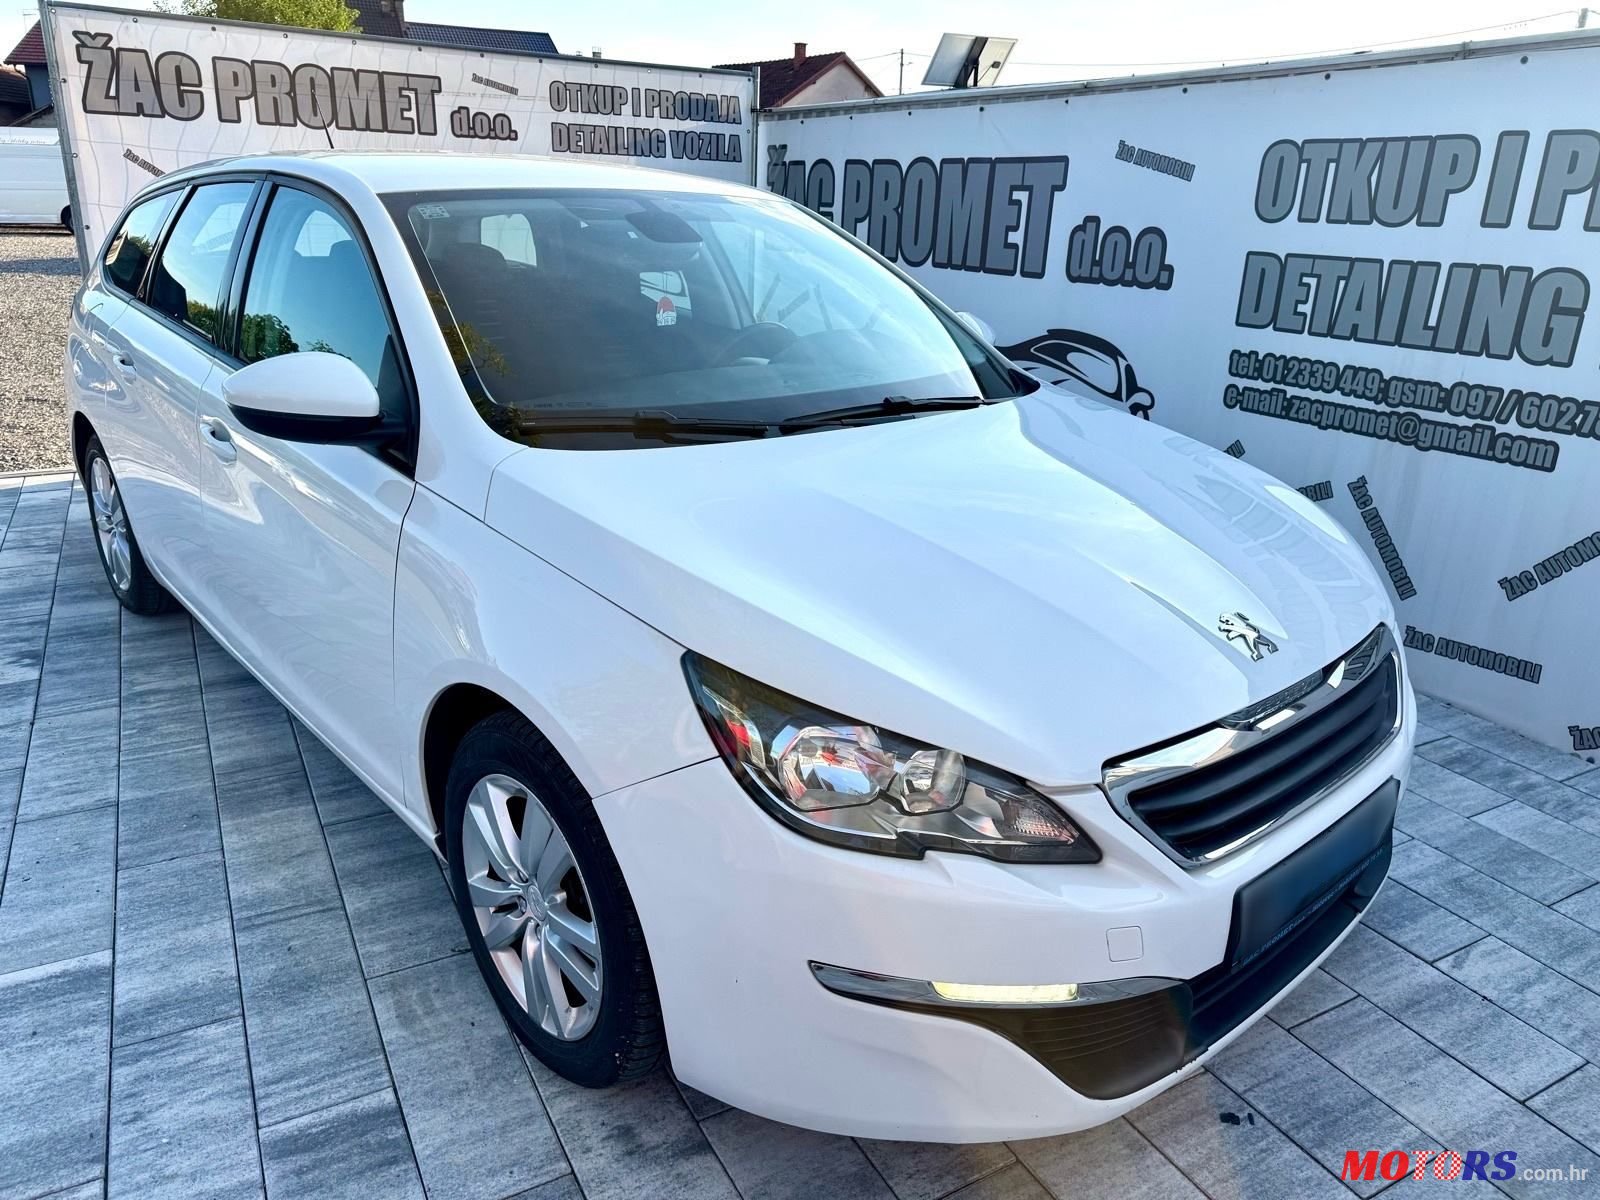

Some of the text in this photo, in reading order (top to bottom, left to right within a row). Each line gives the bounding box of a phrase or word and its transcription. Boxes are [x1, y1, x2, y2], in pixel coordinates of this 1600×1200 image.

[72, 30, 518, 141] ŽAC PROMET d.o.o.
[549, 80, 742, 125] OTKUP I PRODAJA
[551, 122, 742, 162] DETAILING VOZILA
[1115, 139, 1196, 182] ŽAC AUTOMOBILI
[1254, 133, 1481, 227] OTKUP
[1480, 130, 1530, 228] I
[841, 156, 1069, 279] PROMET
[1065, 215, 1174, 290] d.o.o.
[1235, 251, 1590, 368] DETAILING
[1228, 349, 1261, 381] tel:
[1383, 376, 1449, 413] gsm:
[1223, 383, 1560, 473] e-mail: zacpromet@gmail.com
[1347, 475, 1417, 601] ŽAC AUTOMOBILI
[1497, 576, 1538, 602] ŽAC
[1403, 625, 1542, 684] ŽAC AUTOMOBILI
